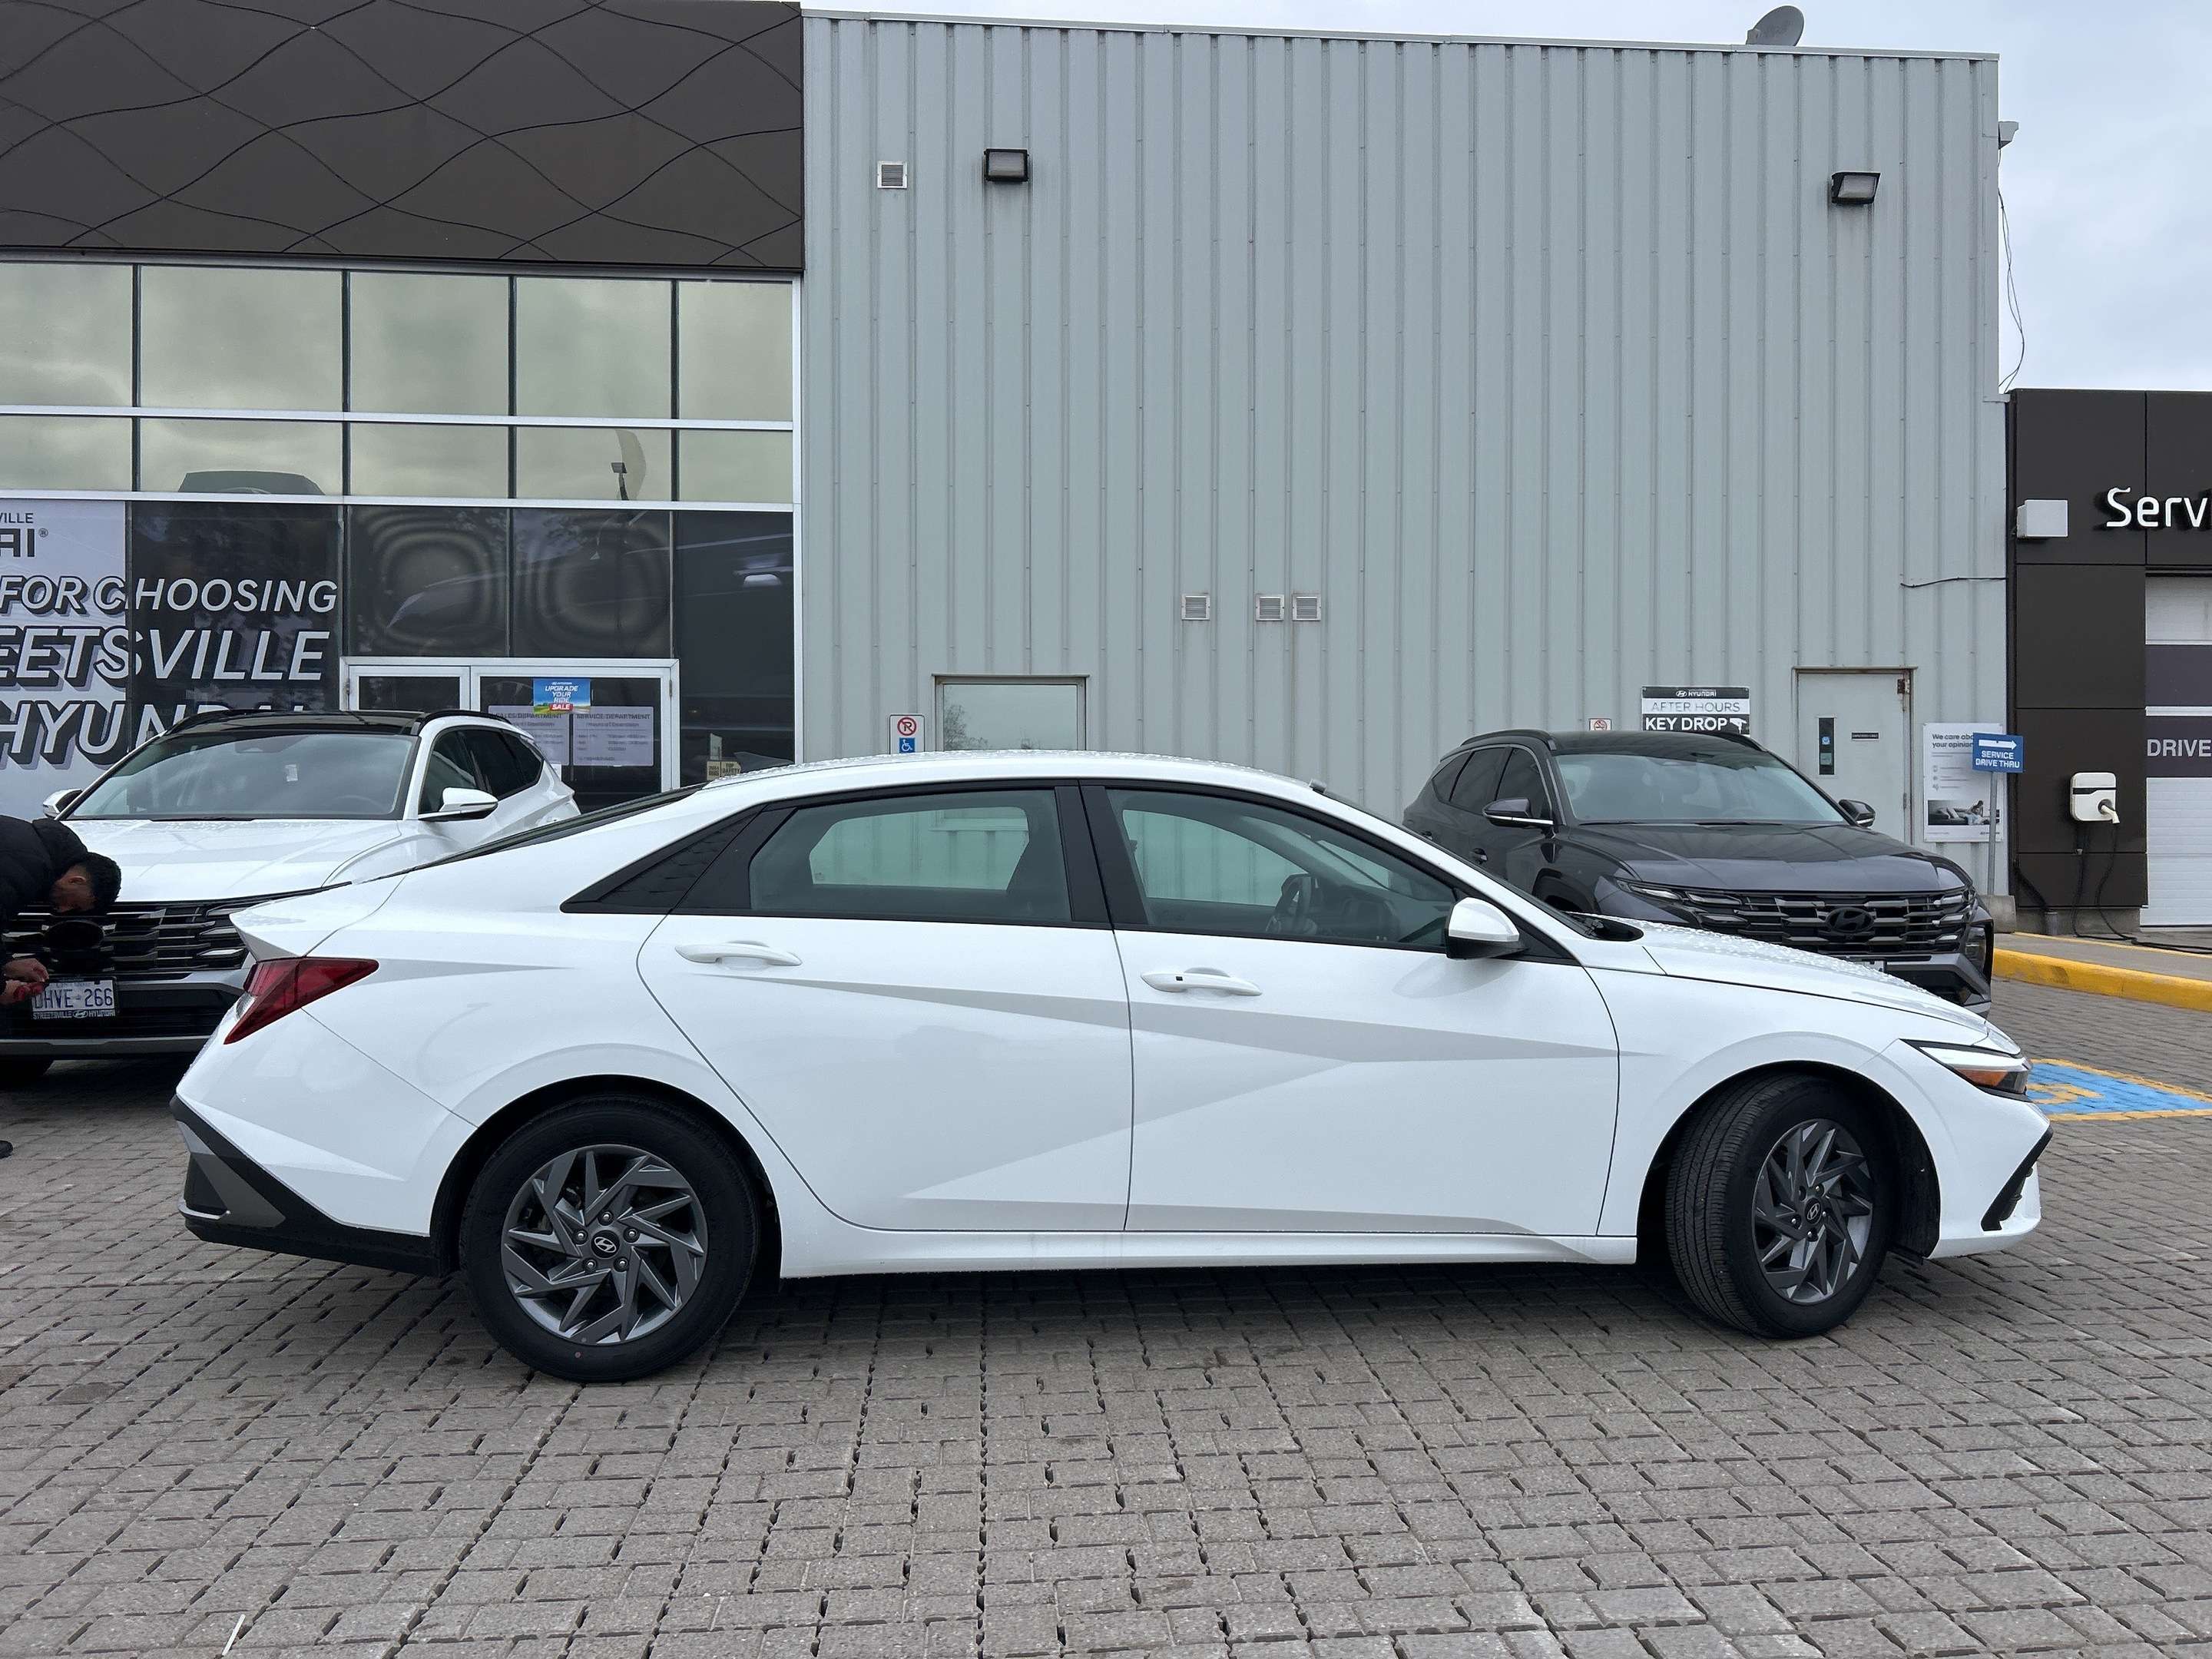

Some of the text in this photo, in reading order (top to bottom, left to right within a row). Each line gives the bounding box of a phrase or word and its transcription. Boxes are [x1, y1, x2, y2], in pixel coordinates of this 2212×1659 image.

[2106, 487, 2208, 527] Serv
[0, 512, 34, 524] ILLE
[0, 575, 339, 614] FOR CHOOSING
[1651, 701, 1740, 713] AFTER HOURS
[1645, 717, 1727, 730] KEY DROP
[1981, 750, 2014, 759] SERVICE
[2147, 739, 2211, 757] DRIVE
[1975, 758, 1998, 767] DRIVE
[84, 988, 113, 1008] 266
